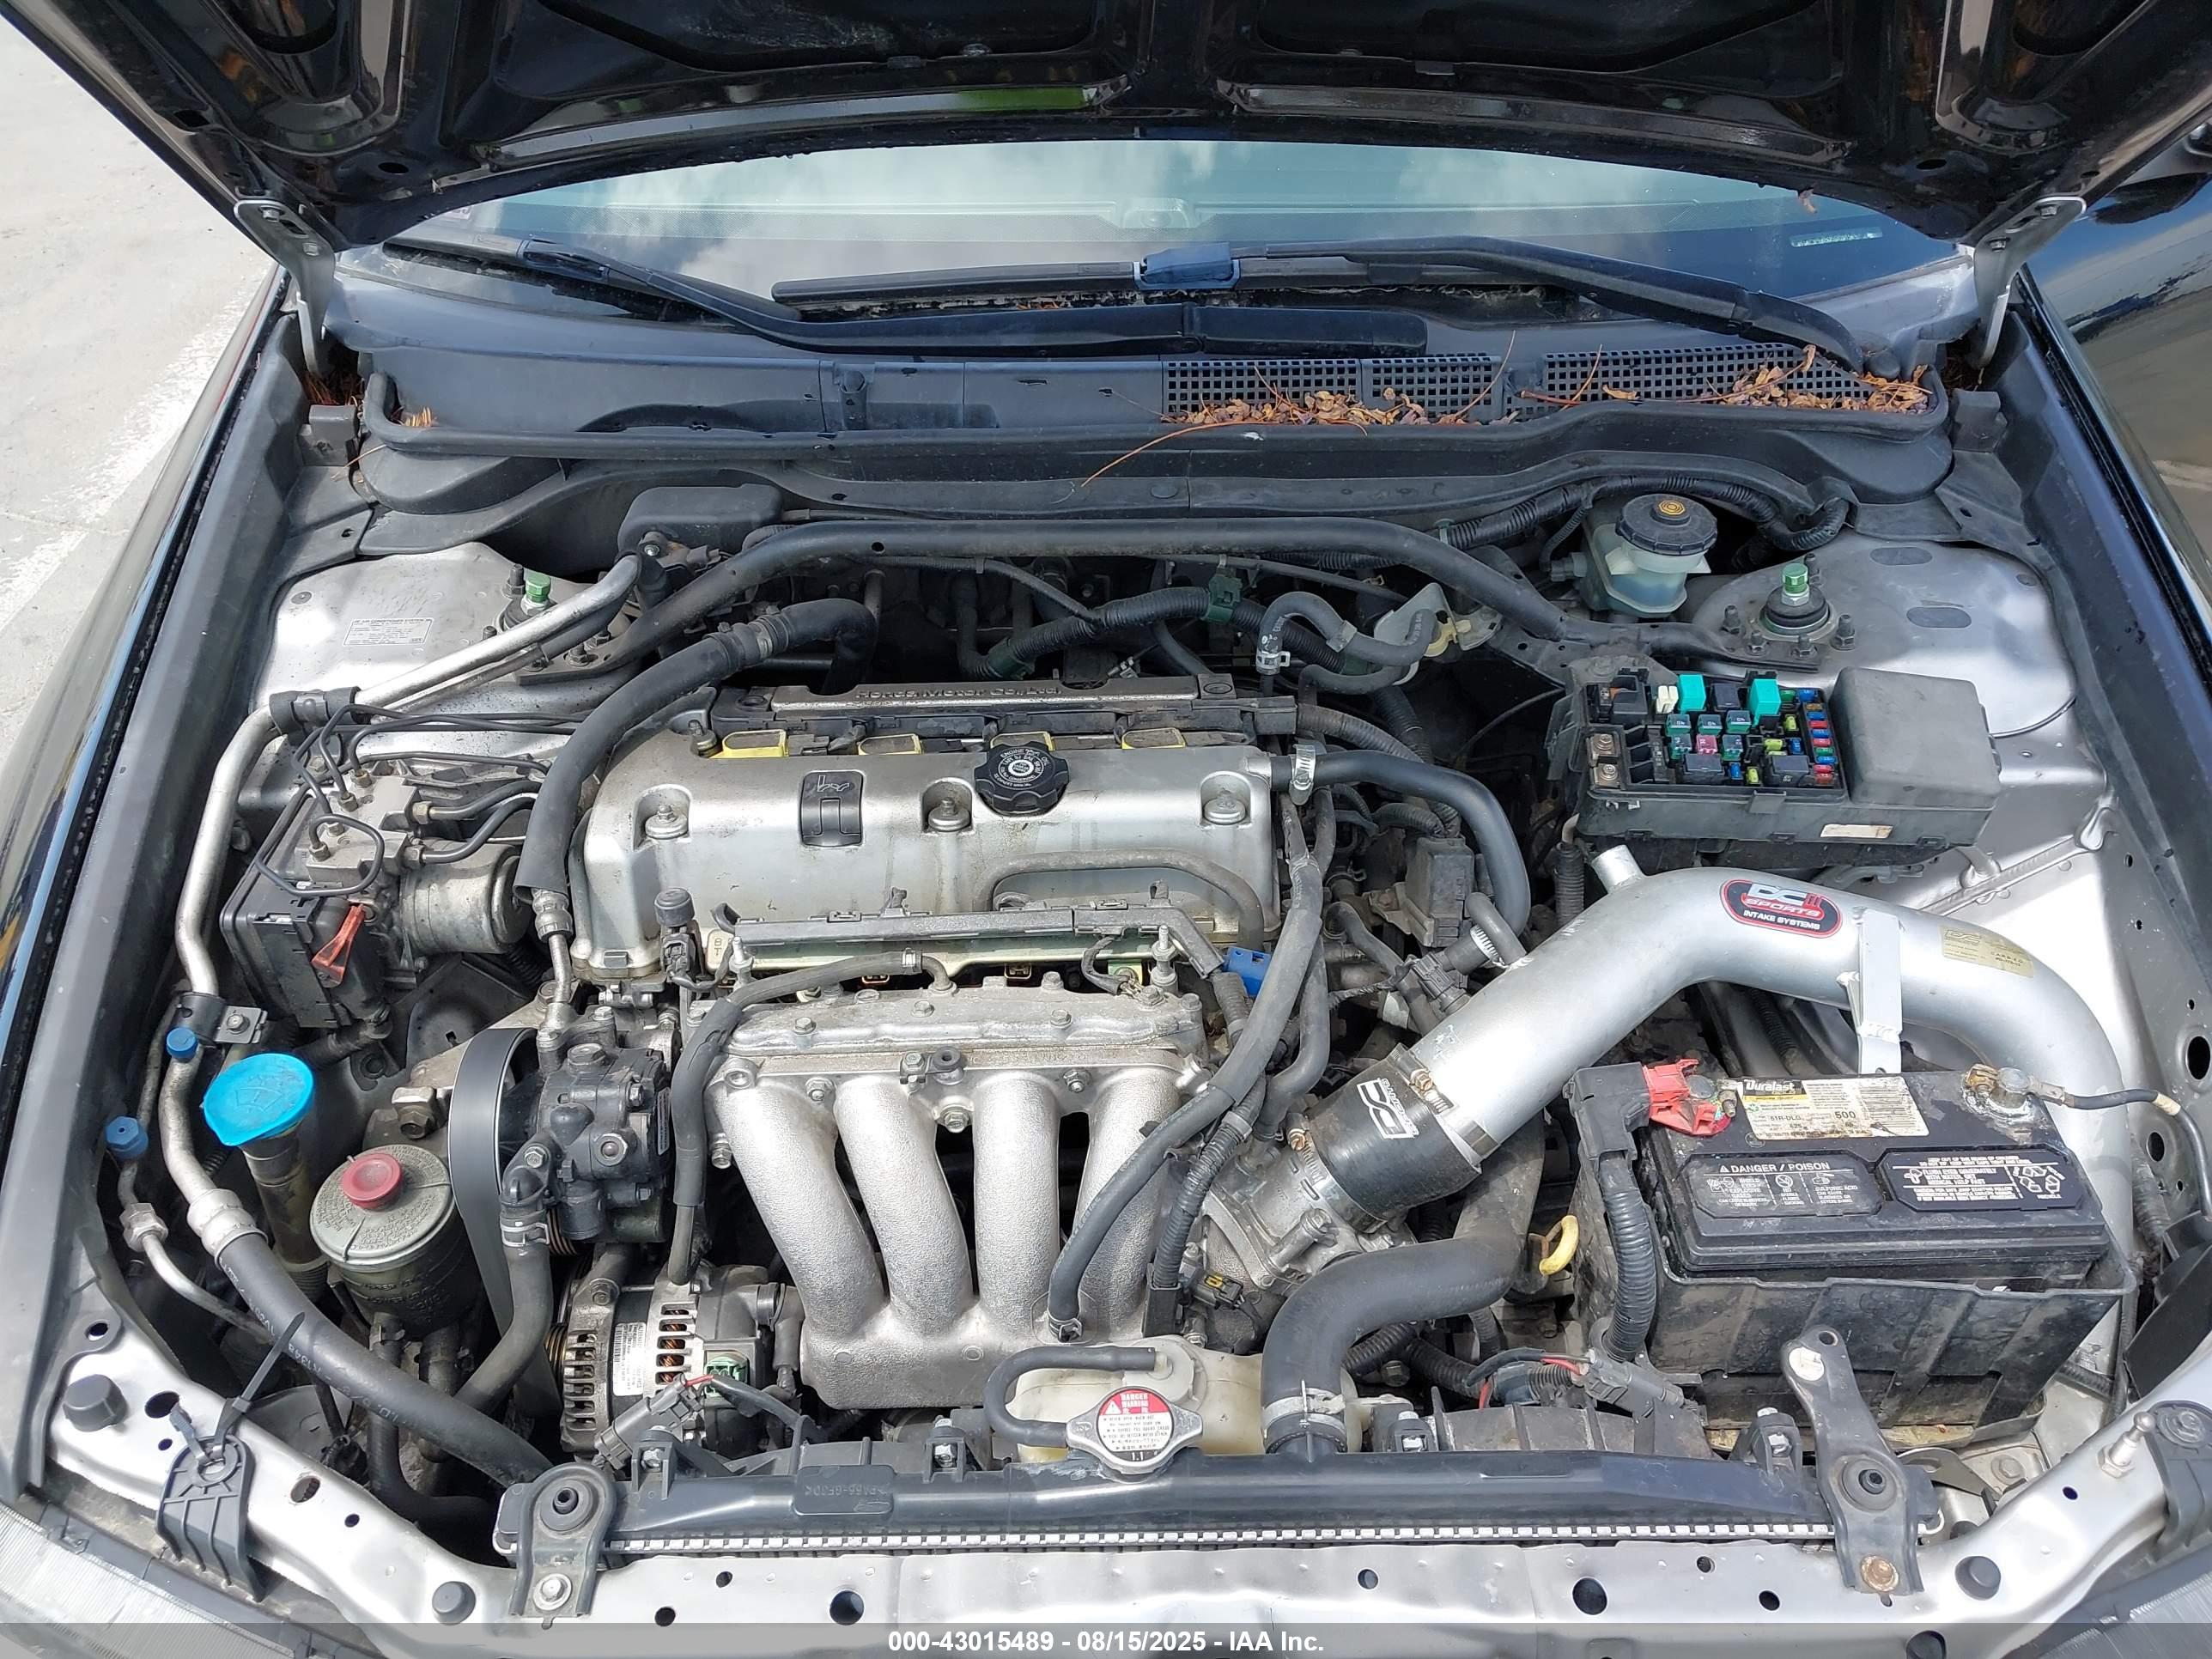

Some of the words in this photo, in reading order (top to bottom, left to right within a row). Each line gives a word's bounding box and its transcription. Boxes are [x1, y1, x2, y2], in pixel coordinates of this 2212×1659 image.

[855, 690, 918, 698] Honda
[922, 689, 981, 698] Motor
[1744, 898, 1821, 918] SPORTS
[1743, 909, 1776, 922] INTAKE
[1777, 917, 1820, 931] SYSTEMS
[1744, 1079, 1796, 1091] Duralast
[1834, 1110, 1856, 1120] 500
[1731, 1164, 1777, 1173] DANGER
[1788, 1162, 1830, 1171] POISON
[1132, 1451, 1144, 1462] 1.1
